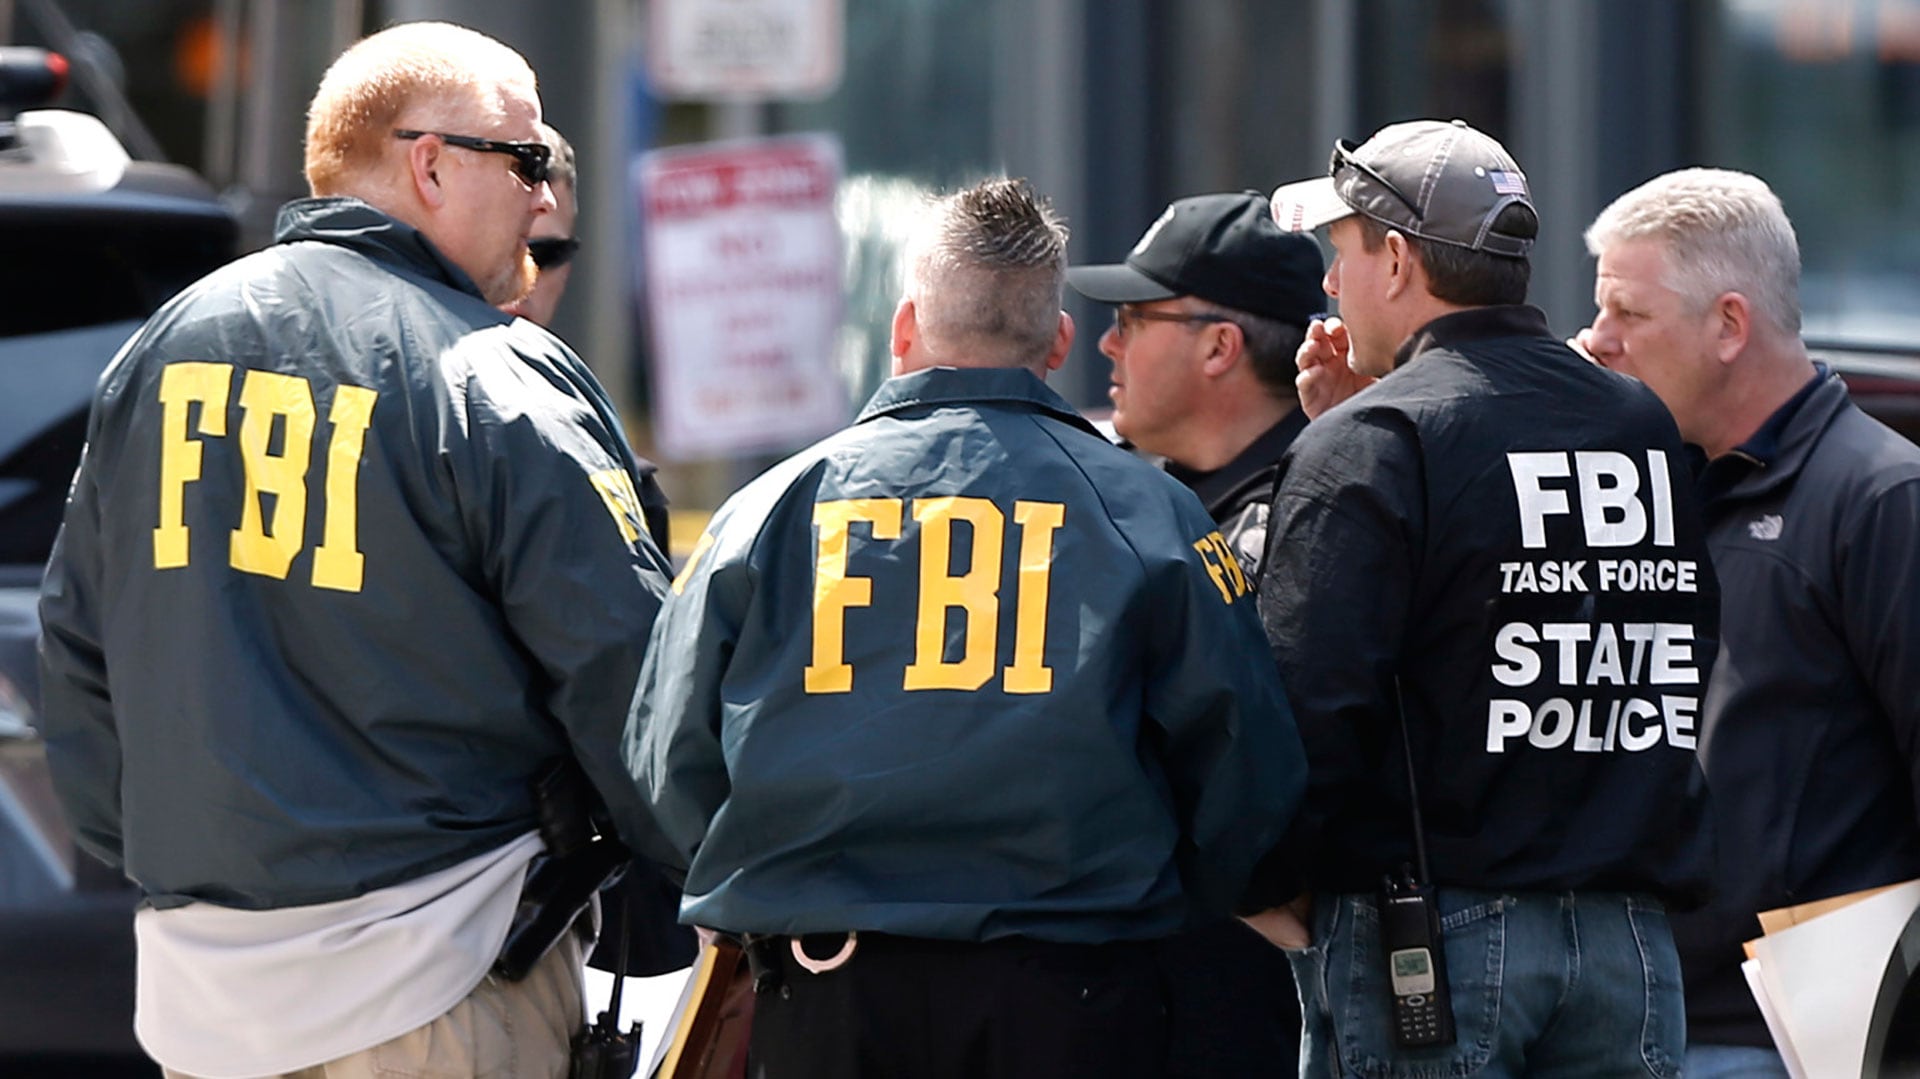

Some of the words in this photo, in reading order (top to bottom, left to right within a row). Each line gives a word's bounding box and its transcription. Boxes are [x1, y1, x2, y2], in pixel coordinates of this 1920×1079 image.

[154, 362, 378, 592] FBI
[1507, 449, 1675, 548] FBI
[805, 497, 1064, 693] FBI
[1192, 531, 1253, 605] FB
[1500, 561, 1589, 592] TASK
[1598, 559, 1697, 592] FORCE
[1491, 621, 1700, 686] STATE
[1486, 694, 1699, 753] POLICE
